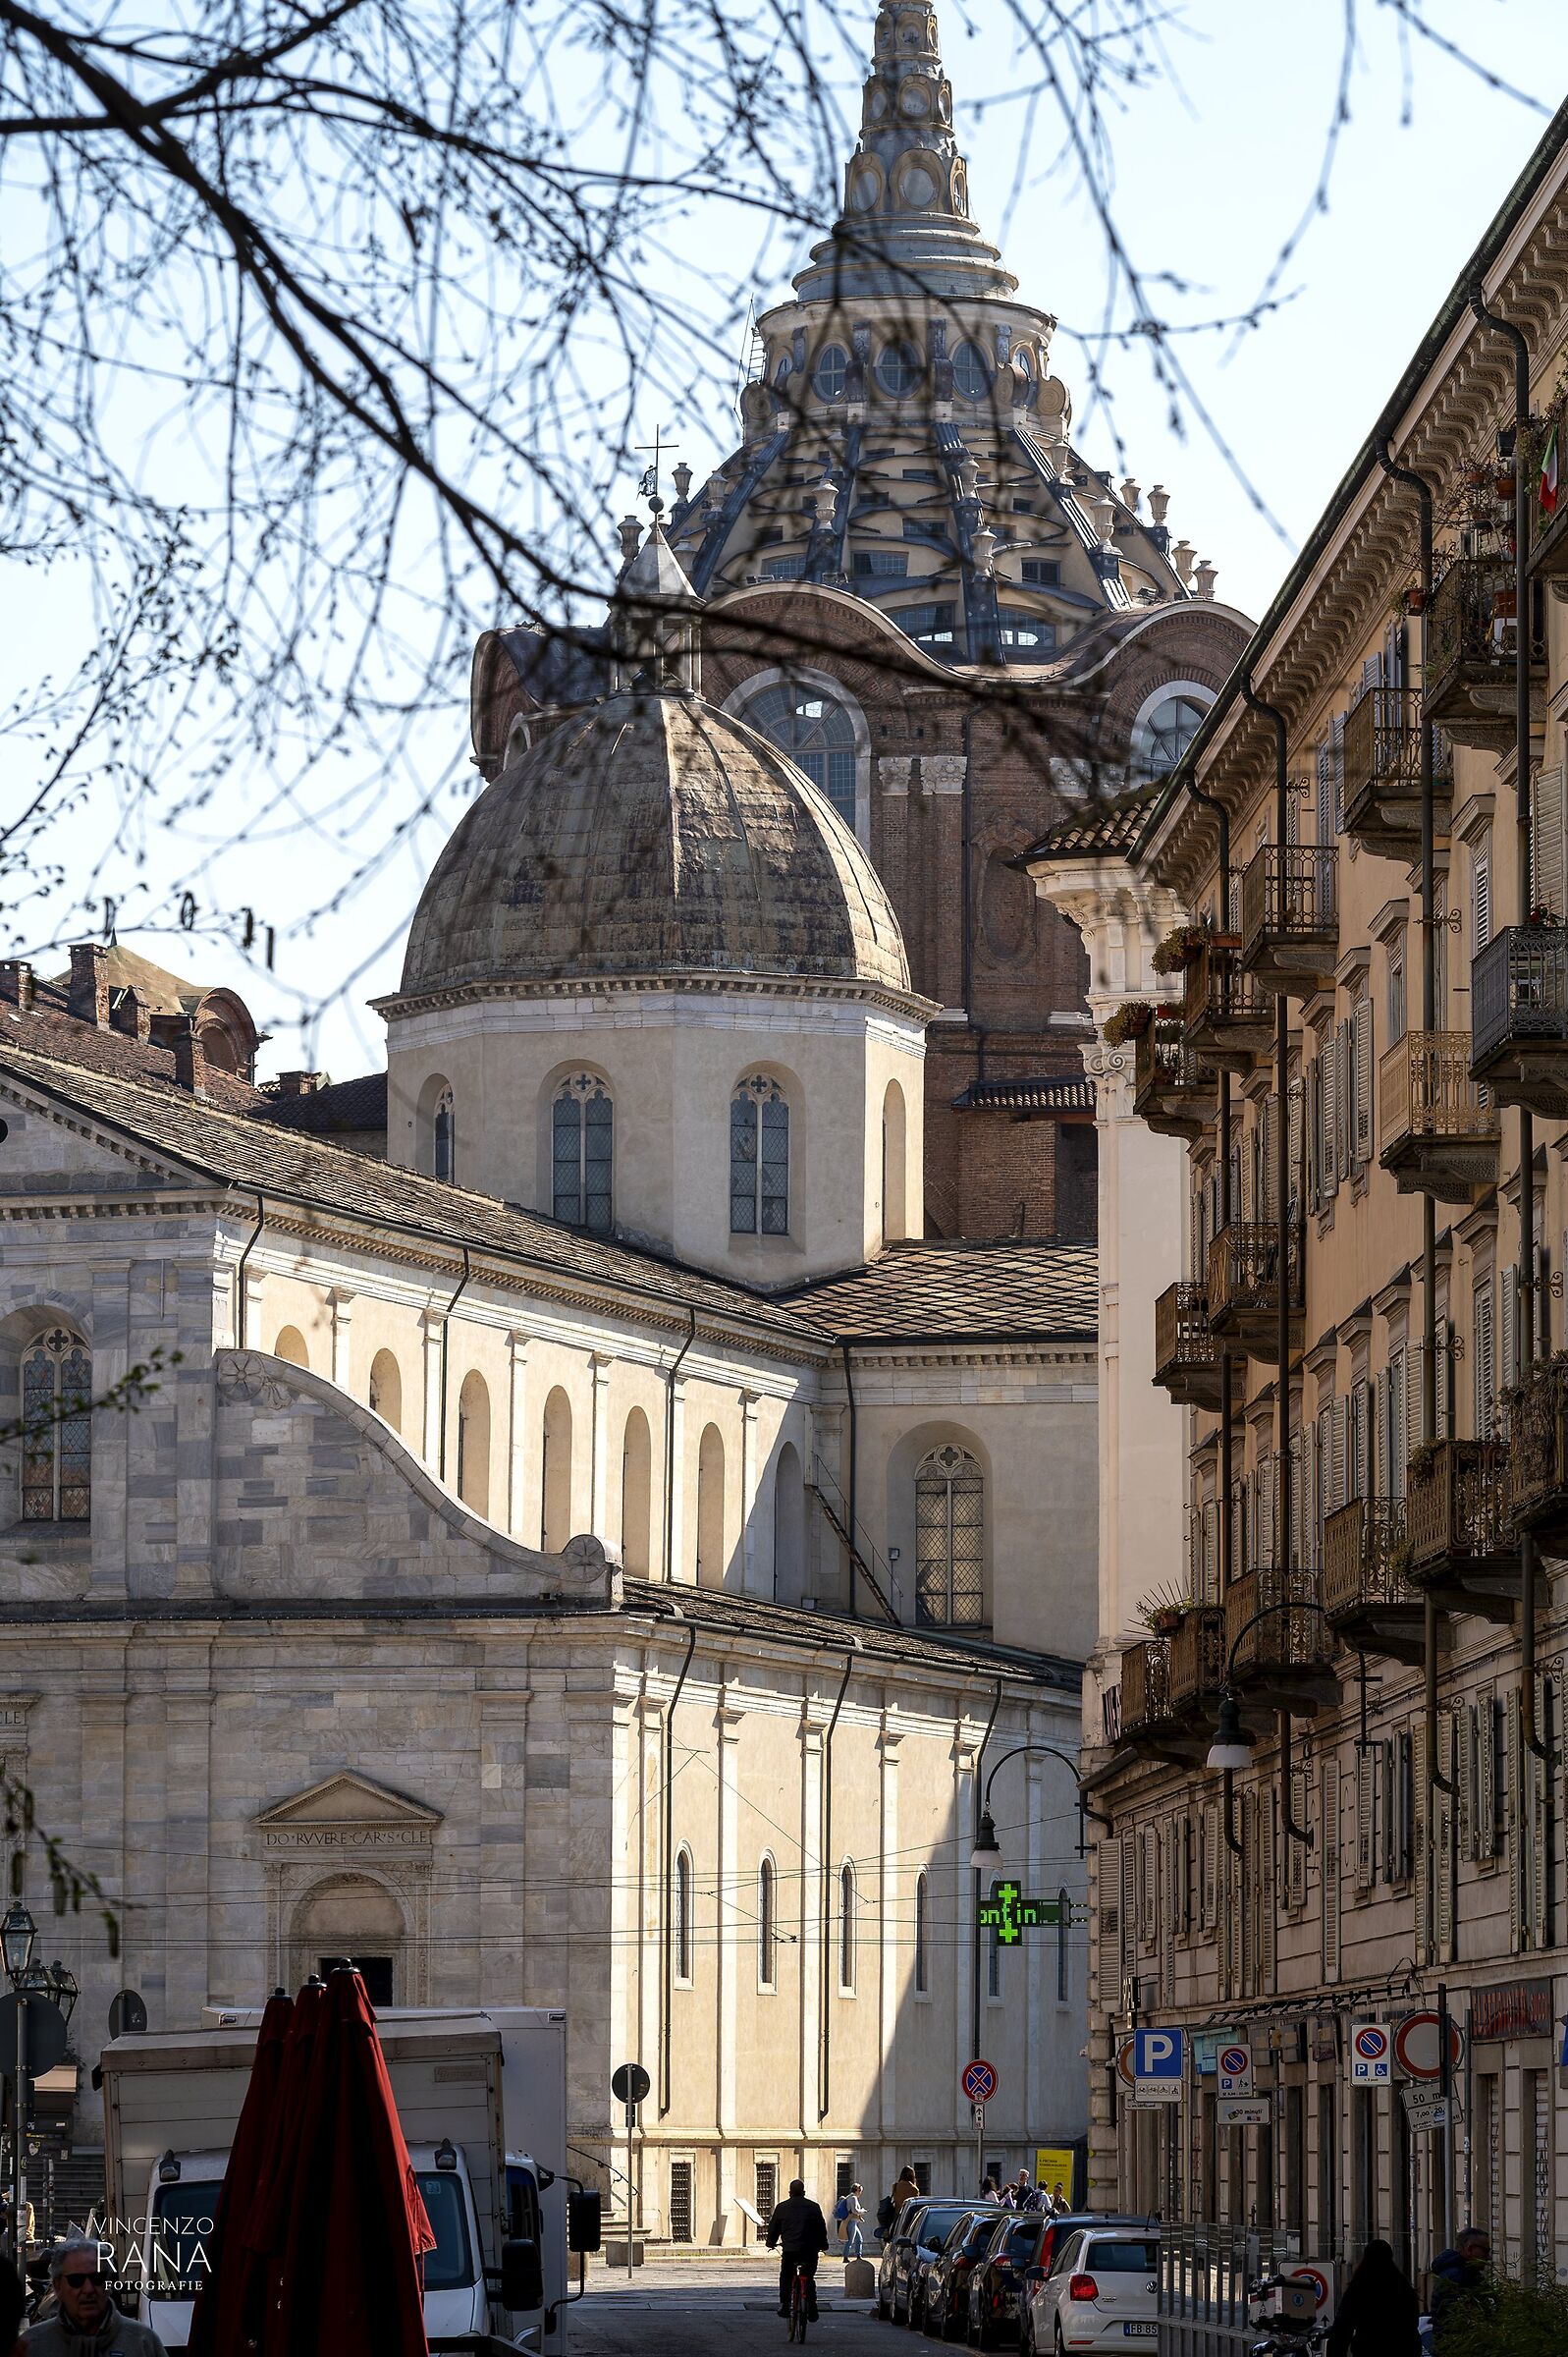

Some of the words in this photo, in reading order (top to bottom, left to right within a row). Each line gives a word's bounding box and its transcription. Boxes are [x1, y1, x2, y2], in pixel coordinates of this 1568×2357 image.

[266, 1833, 290, 1845] DO
[401, 1830, 426, 1843] CLE
[1144, 2034, 1173, 2073] P
[1357, 2064, 1366, 2075] P
[1223, 2079, 1231, 2088] P
[1412, 2093, 1425, 2104] 50
[1131, 2325, 1142, 2333] FB
[1145, 2325, 1157, 2333] 85
